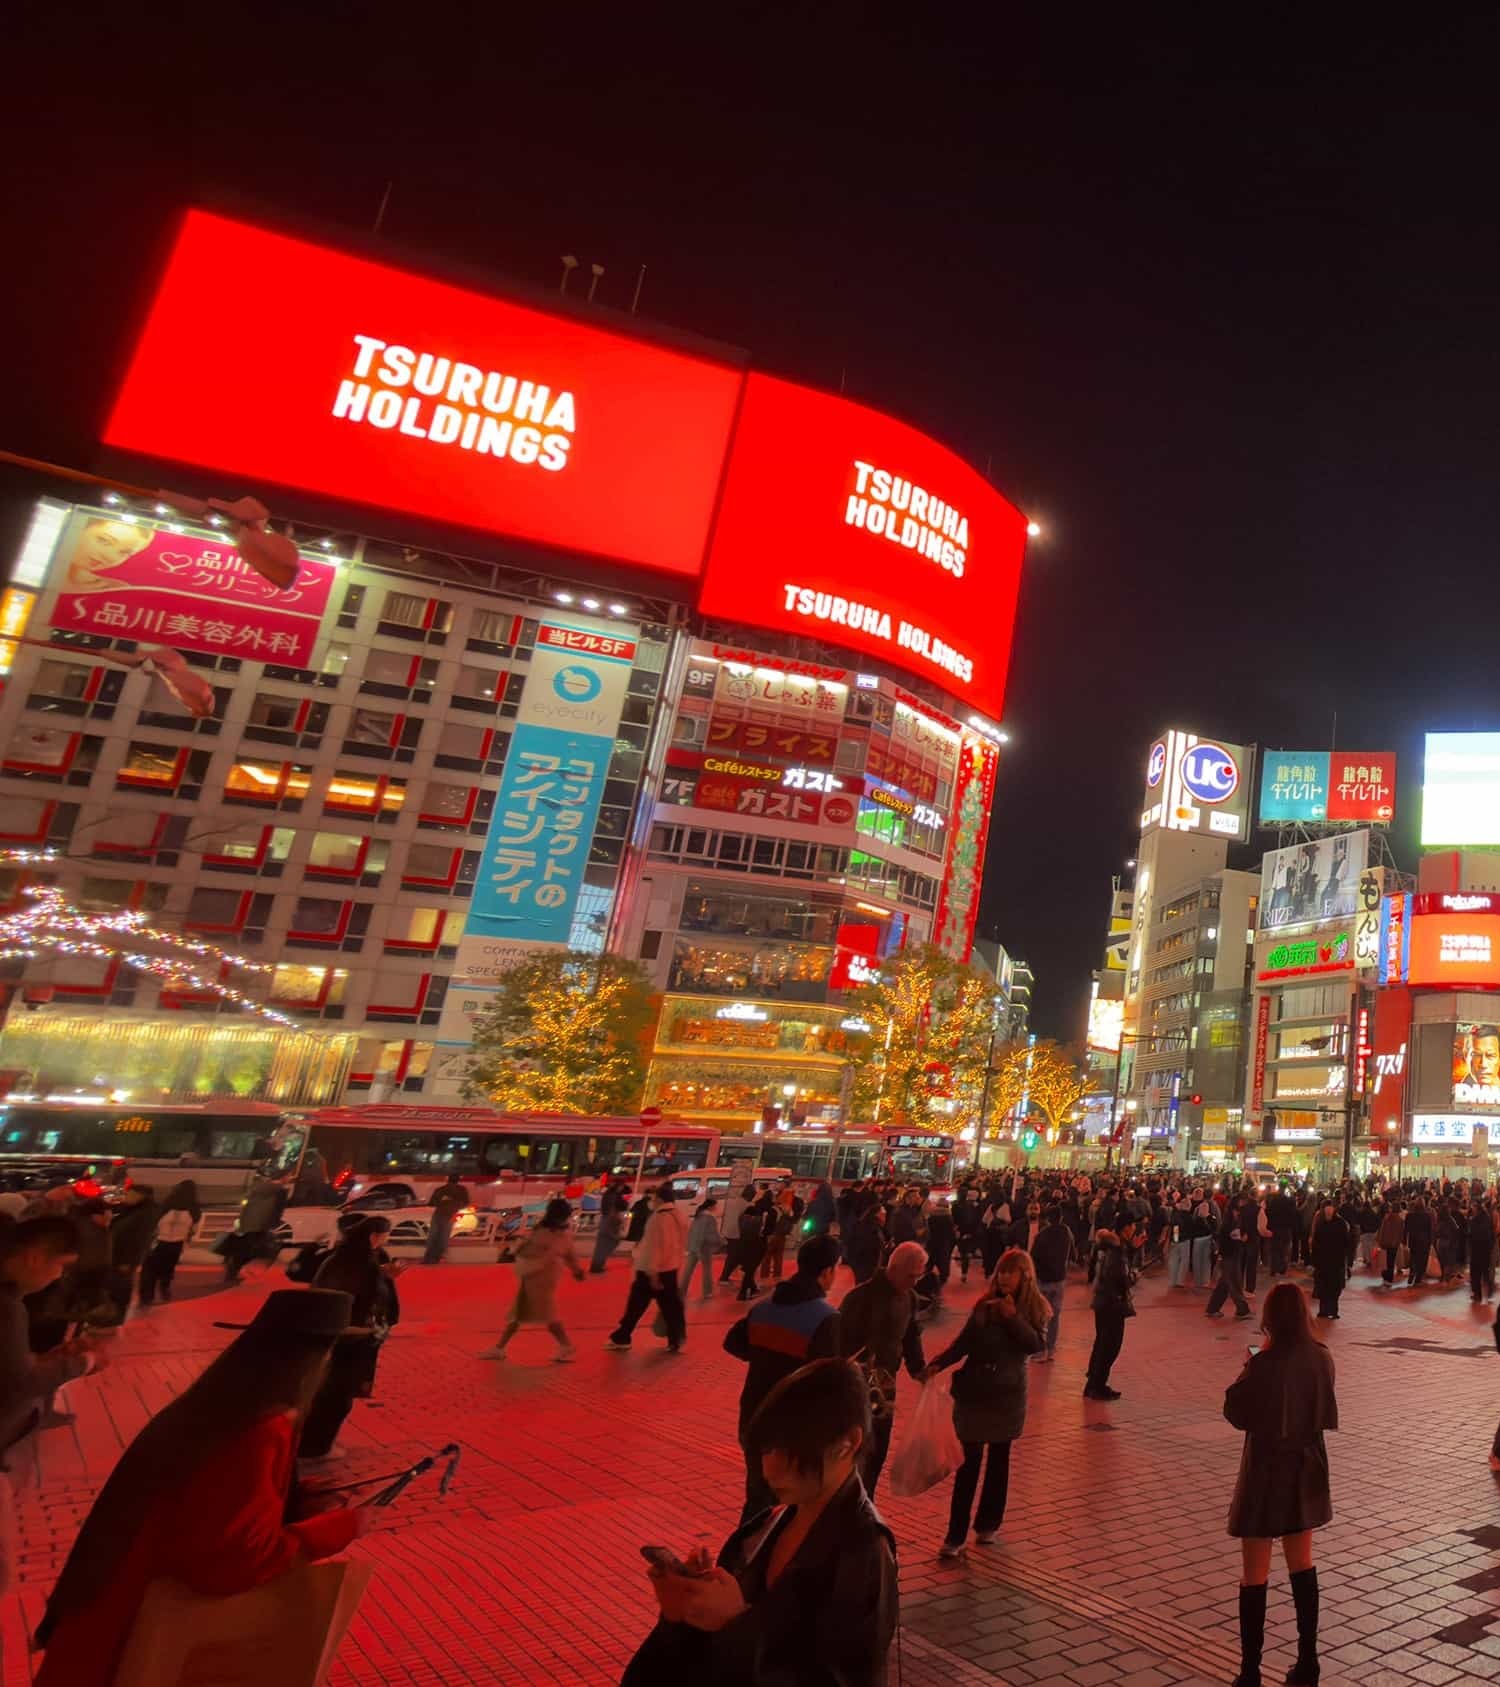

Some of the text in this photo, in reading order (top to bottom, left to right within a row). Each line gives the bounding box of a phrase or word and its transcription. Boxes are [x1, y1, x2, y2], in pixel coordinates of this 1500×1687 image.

[352, 334, 576, 432] TSURUHA
[332, 380, 571, 472] HOLDINGS
[854, 461, 969, 549] TSURUHA
[845, 496, 965, 578] HOLDINGS
[196, 550, 321, 587] 品川ン
[93, 601, 301, 657] 品川美容外科
[548, 629, 627, 654] 当ビル5F
[784, 585, 973, 683] TSURUHA HOLDINGS
[687, 670, 715, 685] 9F
[763, 680, 837, 711] しゃぶ葉
[533, 703, 608, 725] eyecity
[663, 779, 695, 796] 7F
[783, 767, 843, 793] ガスト
[1344, 766, 1383, 782] 龍角散
[737, 788, 814, 818] ガスト
[912, 803, 945, 830] ガスト
[492, 752, 560, 903] アイシティ
[535, 759, 595, 907] コンタクトの
[1263, 906, 1295, 926] RIIZE
[1356, 871, 1381, 963] もんじゃ
